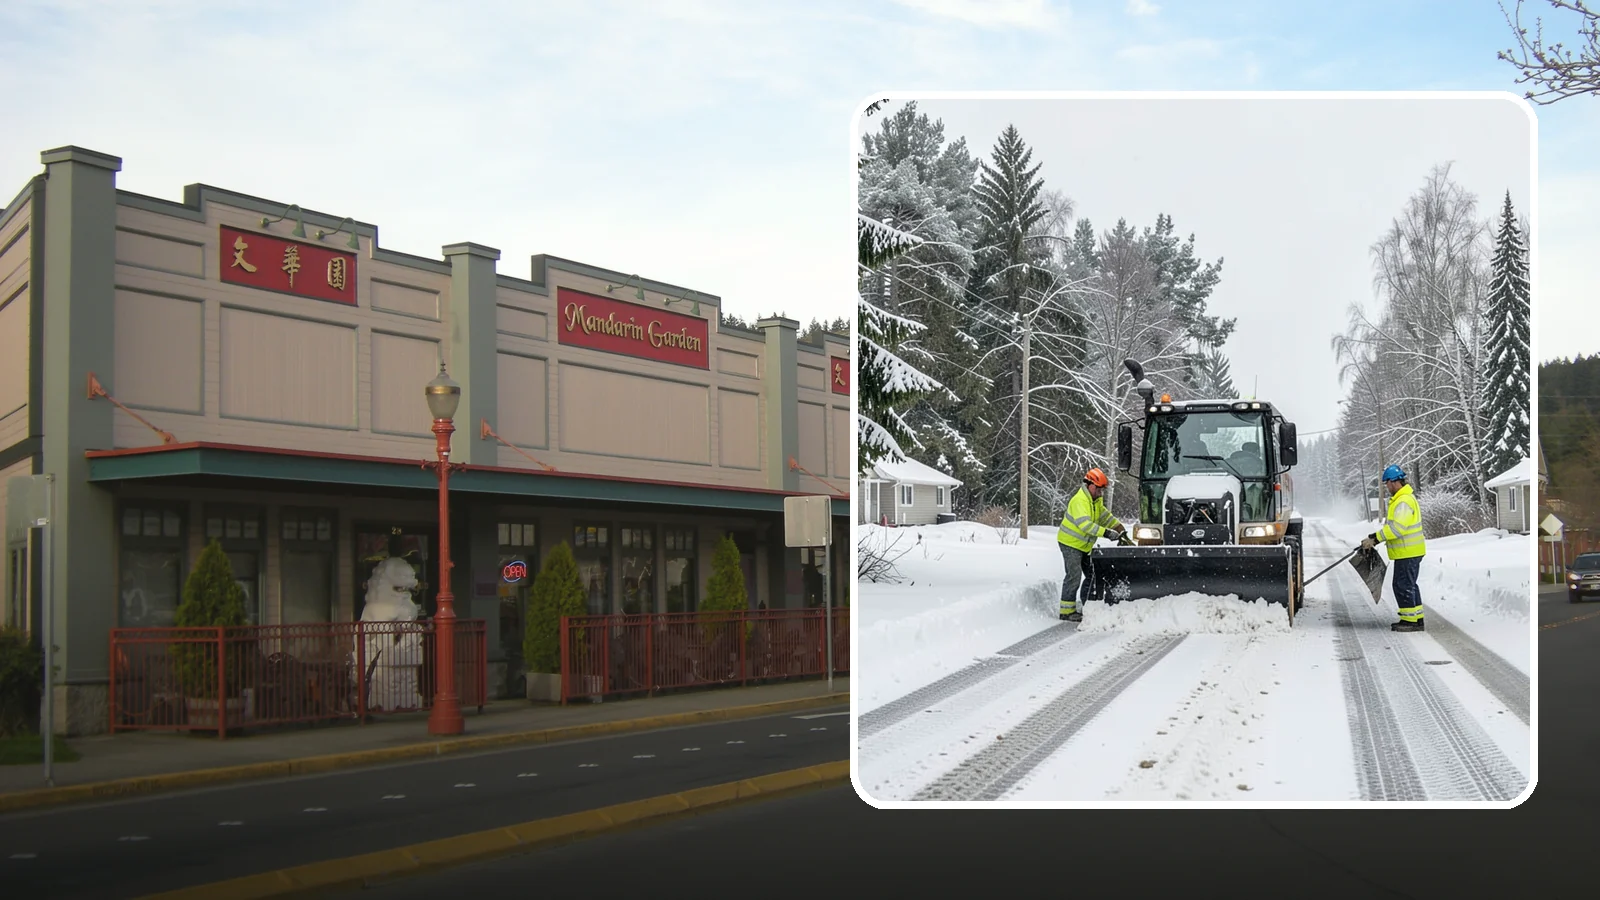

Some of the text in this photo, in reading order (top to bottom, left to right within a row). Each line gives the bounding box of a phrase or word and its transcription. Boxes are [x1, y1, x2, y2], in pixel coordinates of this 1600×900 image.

[230, 235, 347, 291] 文華園
[564, 302, 701, 352] Mandarin Garden
[503, 565, 527, 578] OPEN
